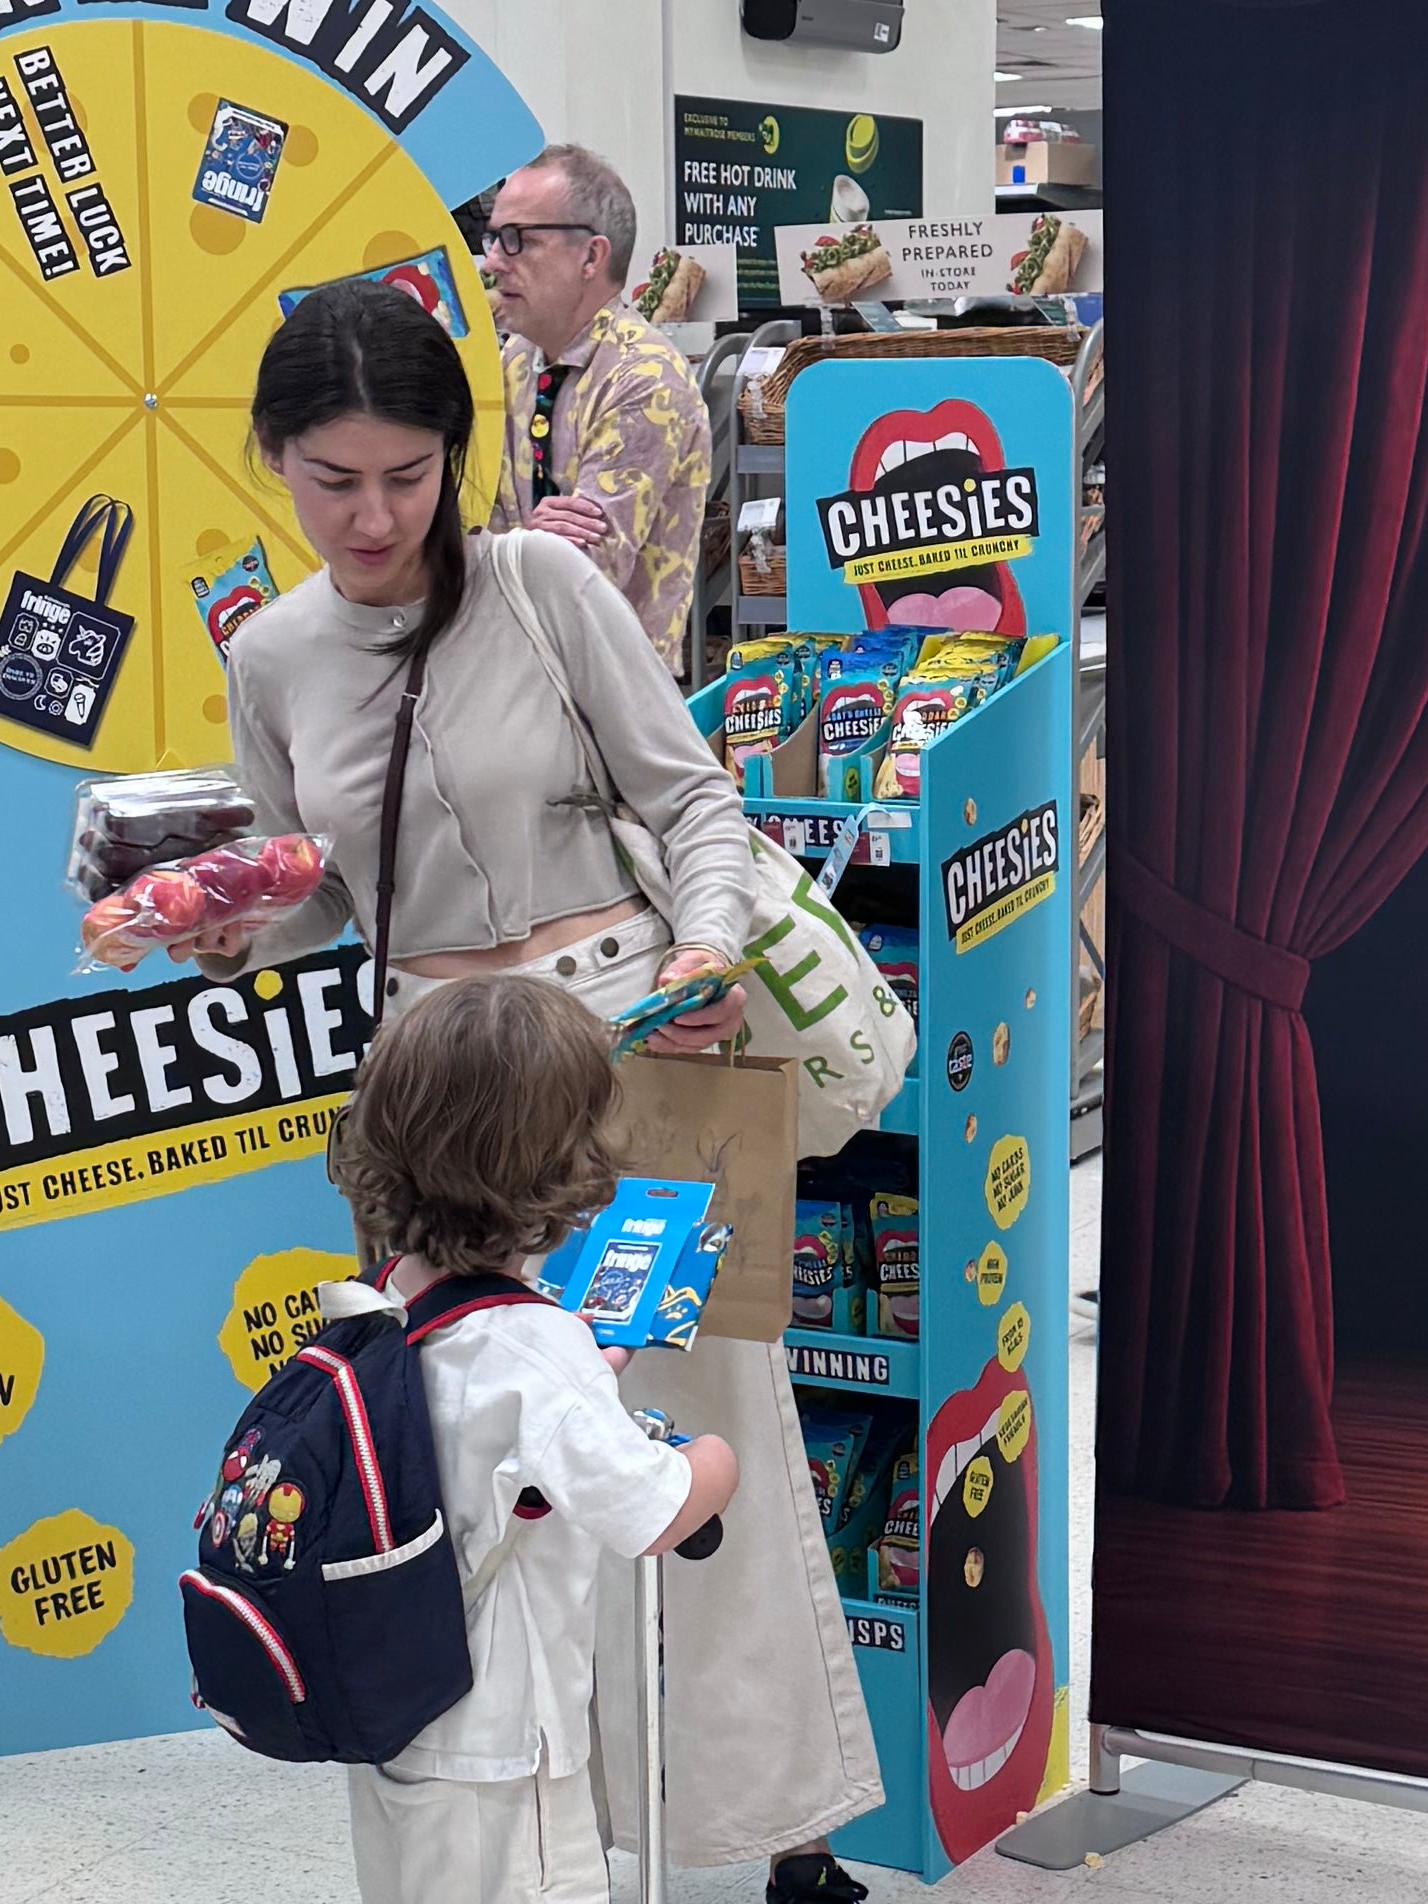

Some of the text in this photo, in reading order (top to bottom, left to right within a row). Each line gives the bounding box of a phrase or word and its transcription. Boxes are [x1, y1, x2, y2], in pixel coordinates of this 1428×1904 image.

[18, 49, 128, 273] BETTER LUCK
[684, 161, 797, 190] FREE HOT DRINK
[684, 192, 757, 216] WITH ANY
[14, 177, 75, 277] TIME!
[684, 223, 759, 247] PURCHASE
[908, 221, 983, 239] FRESHLY
[902, 243, 993, 262] PREPARED
[931, 281, 970, 291] TODAY
[853, 562, 875, 577] JUST
[919, 549, 951, 566] BAKED
[954, 547, 968, 560] TIL
[971, 539, 1020, 557] CRUNCHY
[20, 590, 71, 625] fringe
[147, 1135, 228, 1176] BAKED
[235, 1125, 270, 1154] TIL
[880, 1262, 919, 1282] CHEES
[243, 1302, 277, 1333] NO
[251, 1331, 285, 1361] NO
[884, 1520, 919, 1536] CHEE
[10, 1541, 118, 1595] GLUTEN
[34, 1580, 106, 1626] FREE
